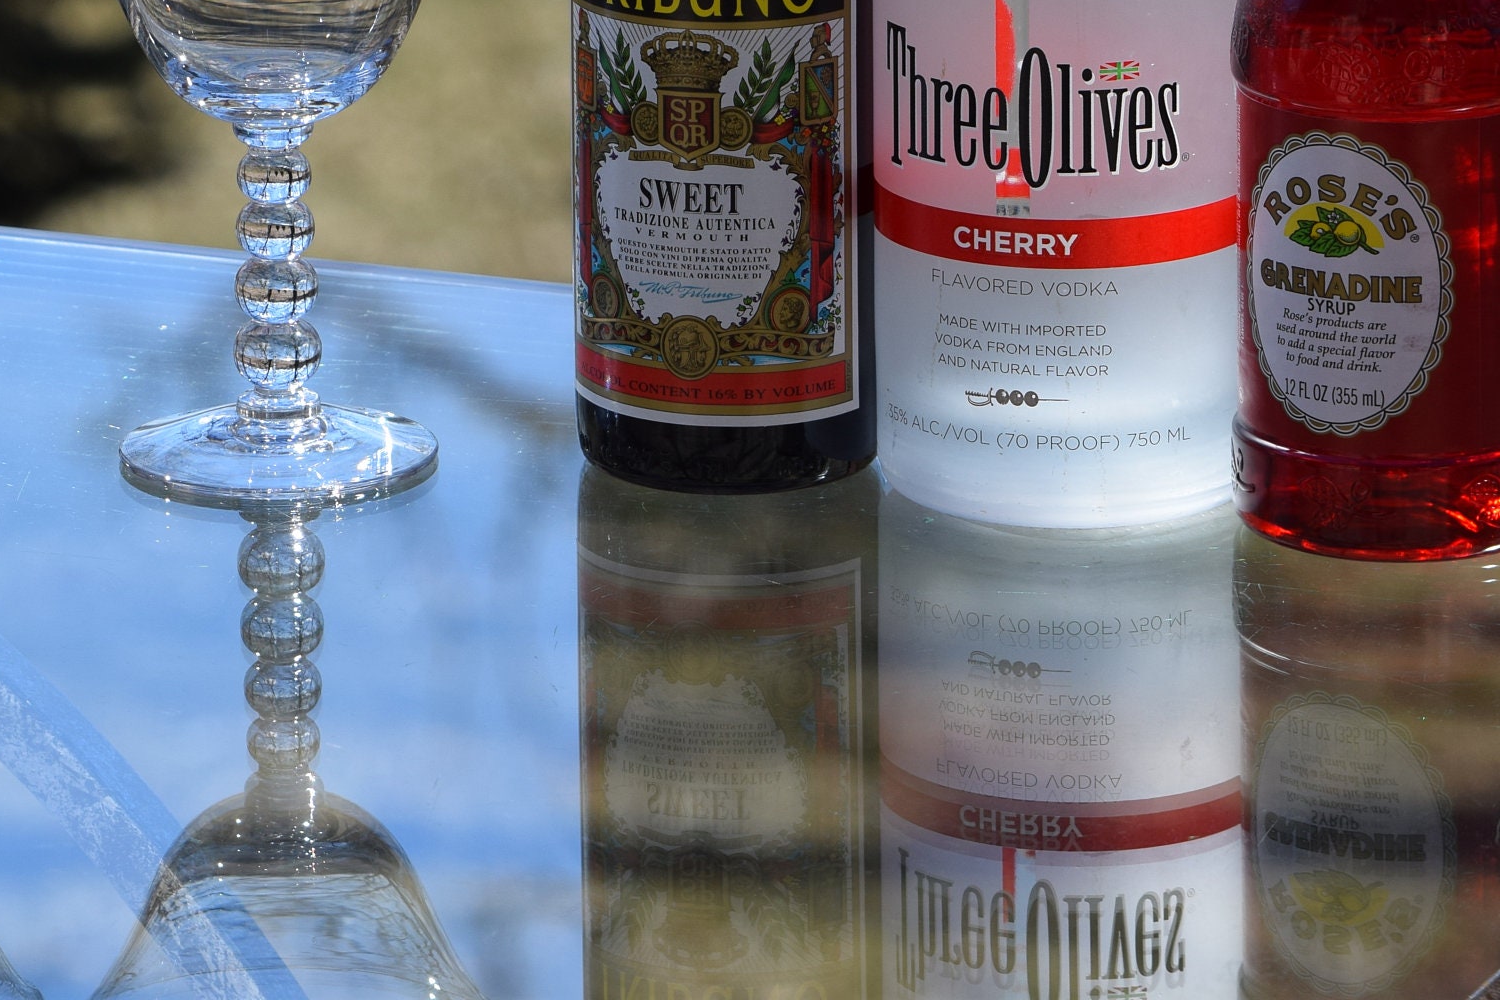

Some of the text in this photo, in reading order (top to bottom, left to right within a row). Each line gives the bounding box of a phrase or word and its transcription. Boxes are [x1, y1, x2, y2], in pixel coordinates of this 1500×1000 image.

[669, 99, 707, 120] SP
[886, 20, 1181, 189] Three Olives
[669, 123, 709, 148] QR
[700, 155, 751, 168] SUPERIORE
[639, 177, 745, 215] SWEET
[1263, 174, 1418, 242] ROSE'S
[614, 207, 775, 231] TRADIZIONE AUTENTICA
[617, 237, 647, 249] QUESTO
[649, 243, 698, 255] VERMOUTH
[635, 227, 749, 242] VERMOUTH
[953, 225, 1079, 256] CHERRY
[620, 246, 640, 256] SOLO
[642, 251, 658, 259] CON
[661, 253, 680, 261] VINI
[727, 256, 767, 264] QUALITA
[624, 255, 645, 265] ERBE
[646, 260, 678, 269] SCELTE
[680, 263, 710, 271] NELLA
[625, 263, 650, 274] DELLA
[652, 268, 694, 279] FORMULA
[931, 268, 1119, 297] FLAVORED VODKA
[1260, 258, 1423, 304] GRENADINE
[1307, 297, 1356, 315] SYRUP
[939, 313, 1106, 337] MADE WITH IMPORTED
[1283, 307, 1387, 334] Rose's products are
[934, 332, 1113, 357] VODKA FROM ENGLAND
[1276, 321, 1396, 345] used around the world
[1277, 334, 1395, 363] to add a special flavor
[938, 353, 1109, 377] AND NATURAL FLAVOR
[1286, 350, 1382, 374] to food and drink.
[629, 380, 702, 400] CONTENT
[708, 389, 738, 400] 16%
[744, 389, 766, 399] BY
[772, 379, 835, 399] VOLUME
[1284, 377, 1385, 408] 12 FL OZ (355 mL)
[888, 402, 1191, 451] 35% ALC./VOL (70 PROOF) 750 ML
